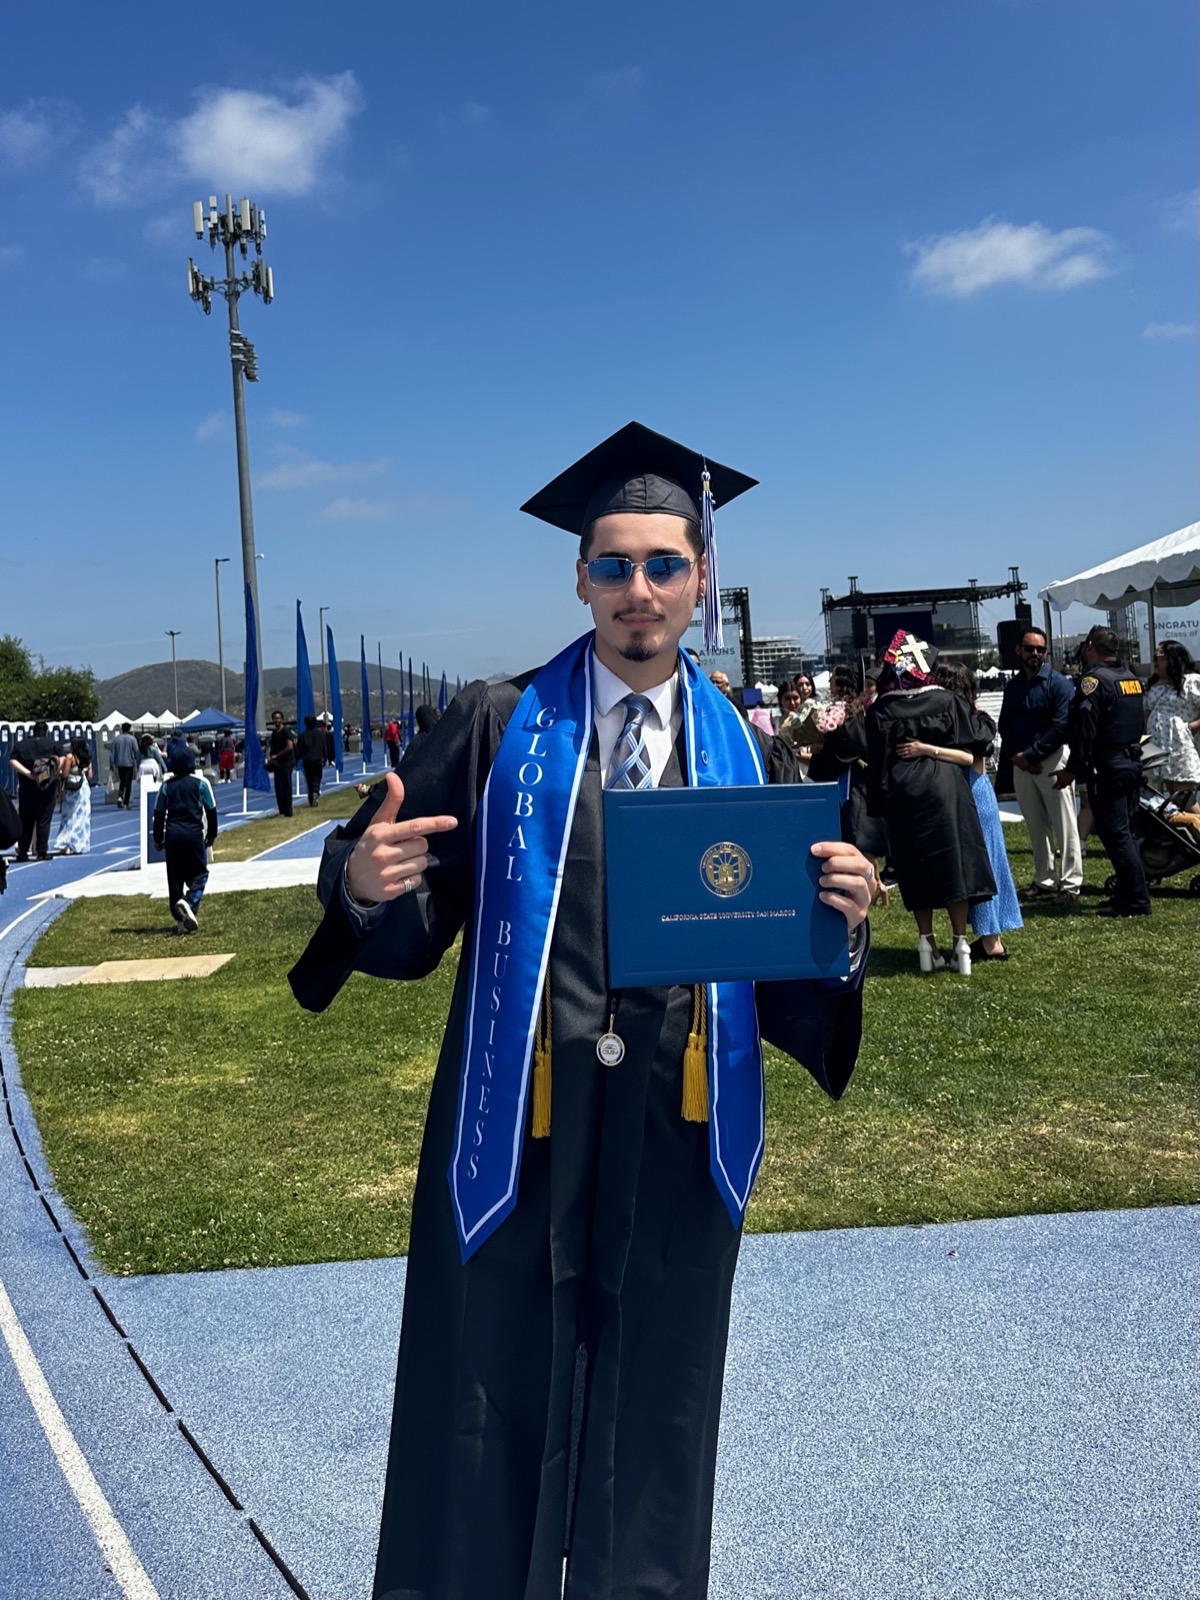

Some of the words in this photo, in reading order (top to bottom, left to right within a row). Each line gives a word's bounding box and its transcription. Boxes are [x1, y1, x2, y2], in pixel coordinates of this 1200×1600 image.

[506, 706, 557, 882] GLOBAL
[661, 914, 699, 922] CALIFORNIA
[699, 912, 718, 920] STATE
[719, 911, 755, 919] UNIVERSITY
[757, 910, 769, 918] SAN
[769, 909, 796, 917] MARCOS
[468, 920, 512, 1180] BUSINESS
